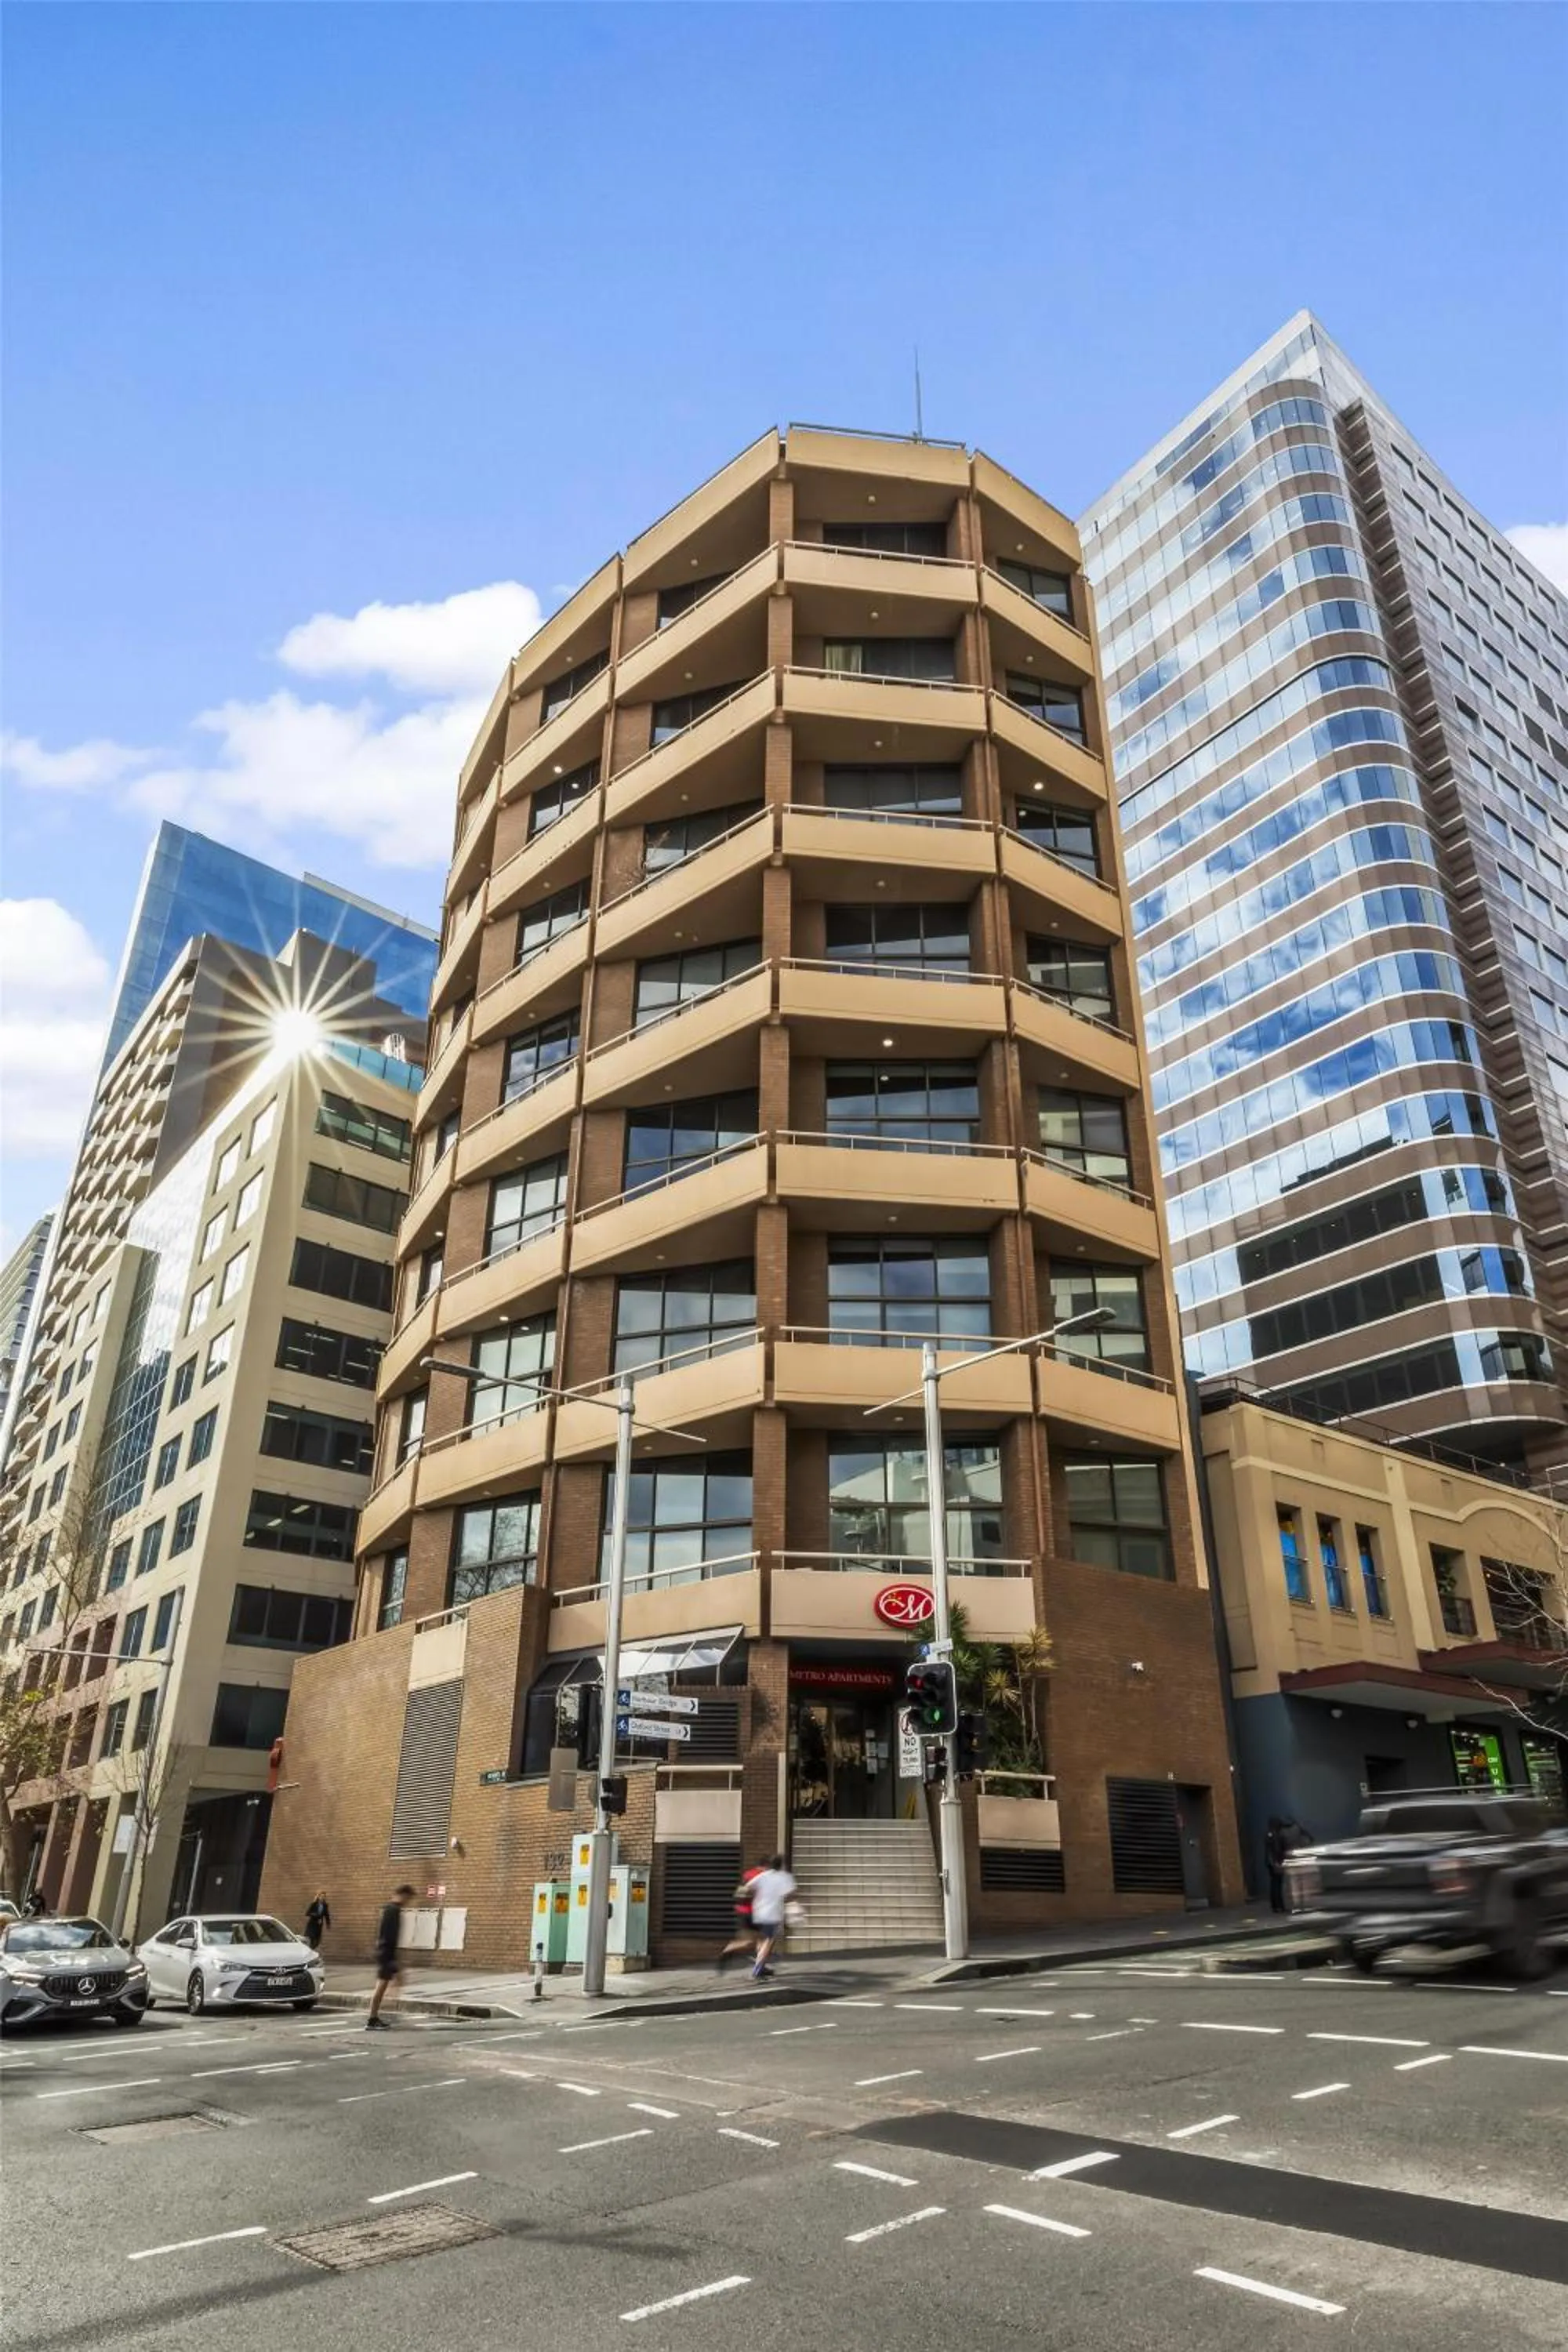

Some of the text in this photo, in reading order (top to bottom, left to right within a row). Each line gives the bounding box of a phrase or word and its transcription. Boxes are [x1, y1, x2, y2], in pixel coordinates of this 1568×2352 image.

[788, 1669, 891, 1685] METRO APARTMENTS
[904, 1737, 916, 1747] NO
